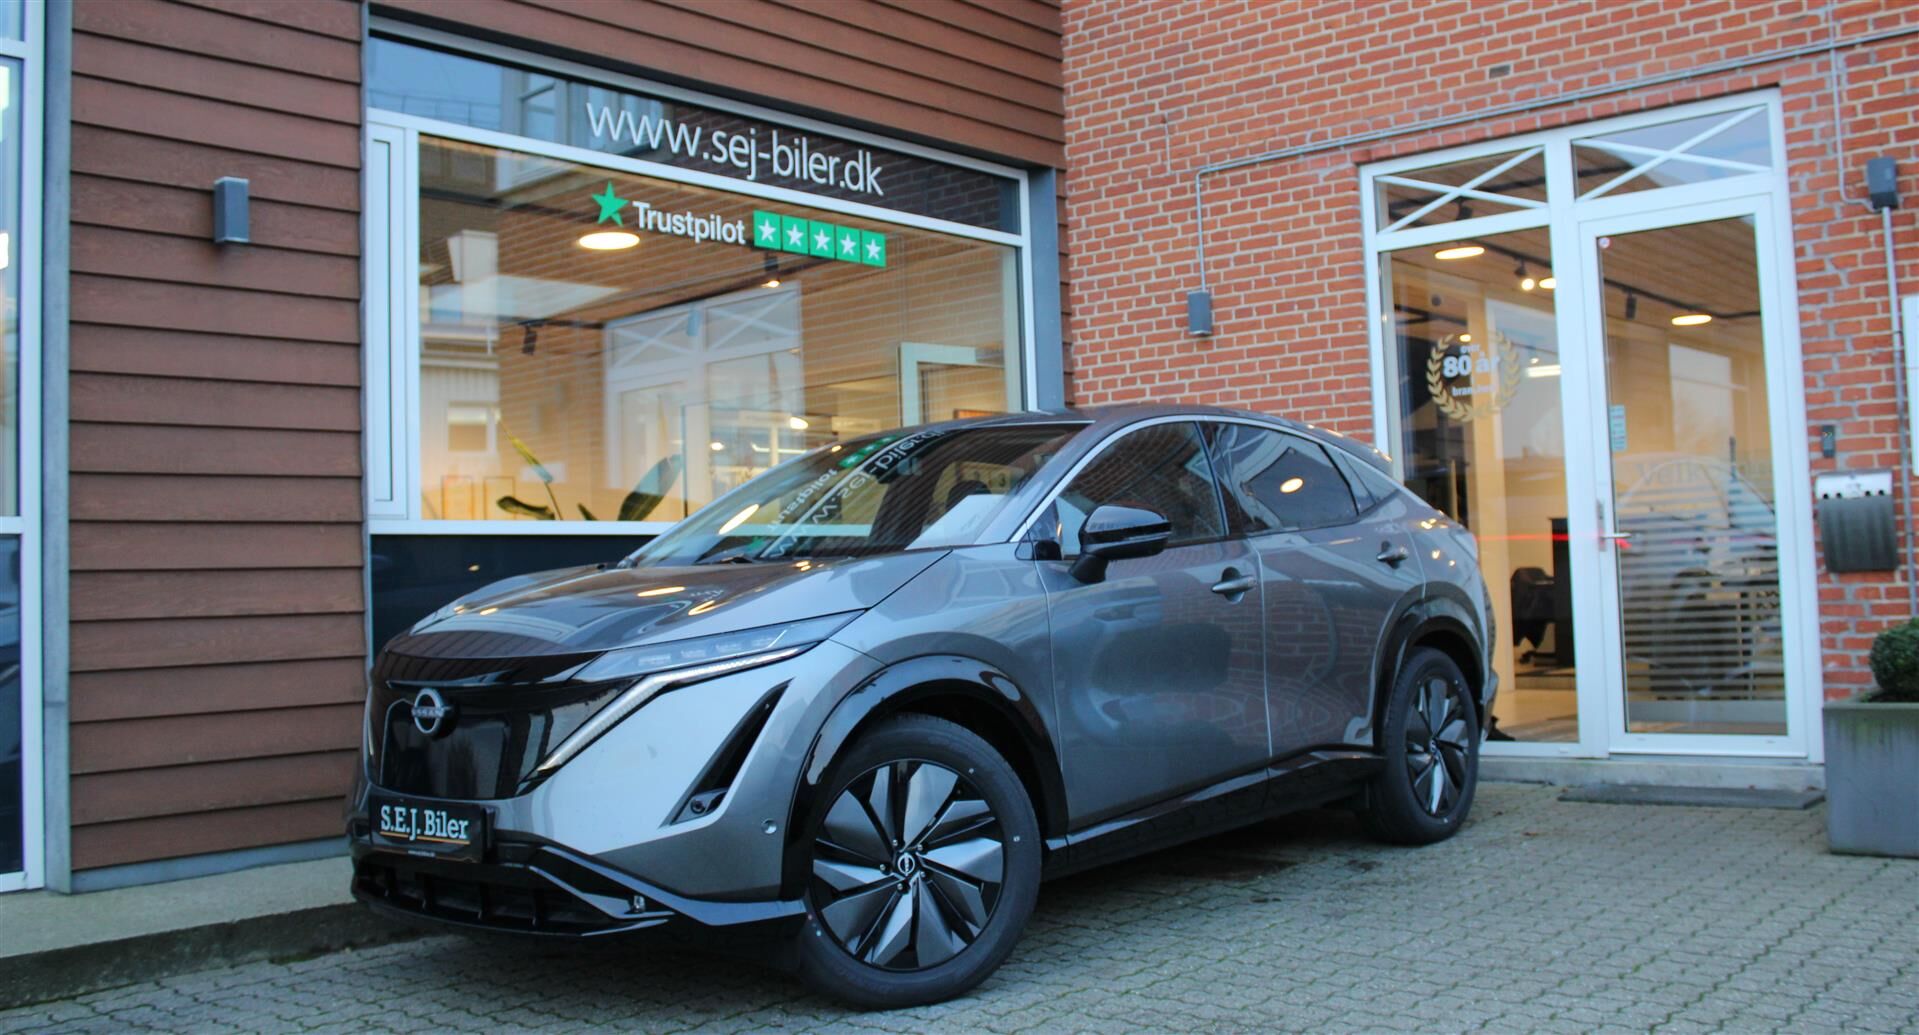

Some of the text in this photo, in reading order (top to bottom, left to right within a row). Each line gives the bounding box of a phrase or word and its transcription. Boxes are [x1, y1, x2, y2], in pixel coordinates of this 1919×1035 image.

[586, 102, 884, 196] www.sej-biler.dk
[632, 200, 747, 245] Trustpilot
[1443, 355, 1472, 378] 80
[381, 805, 469, 841] S.E.J. Biler
